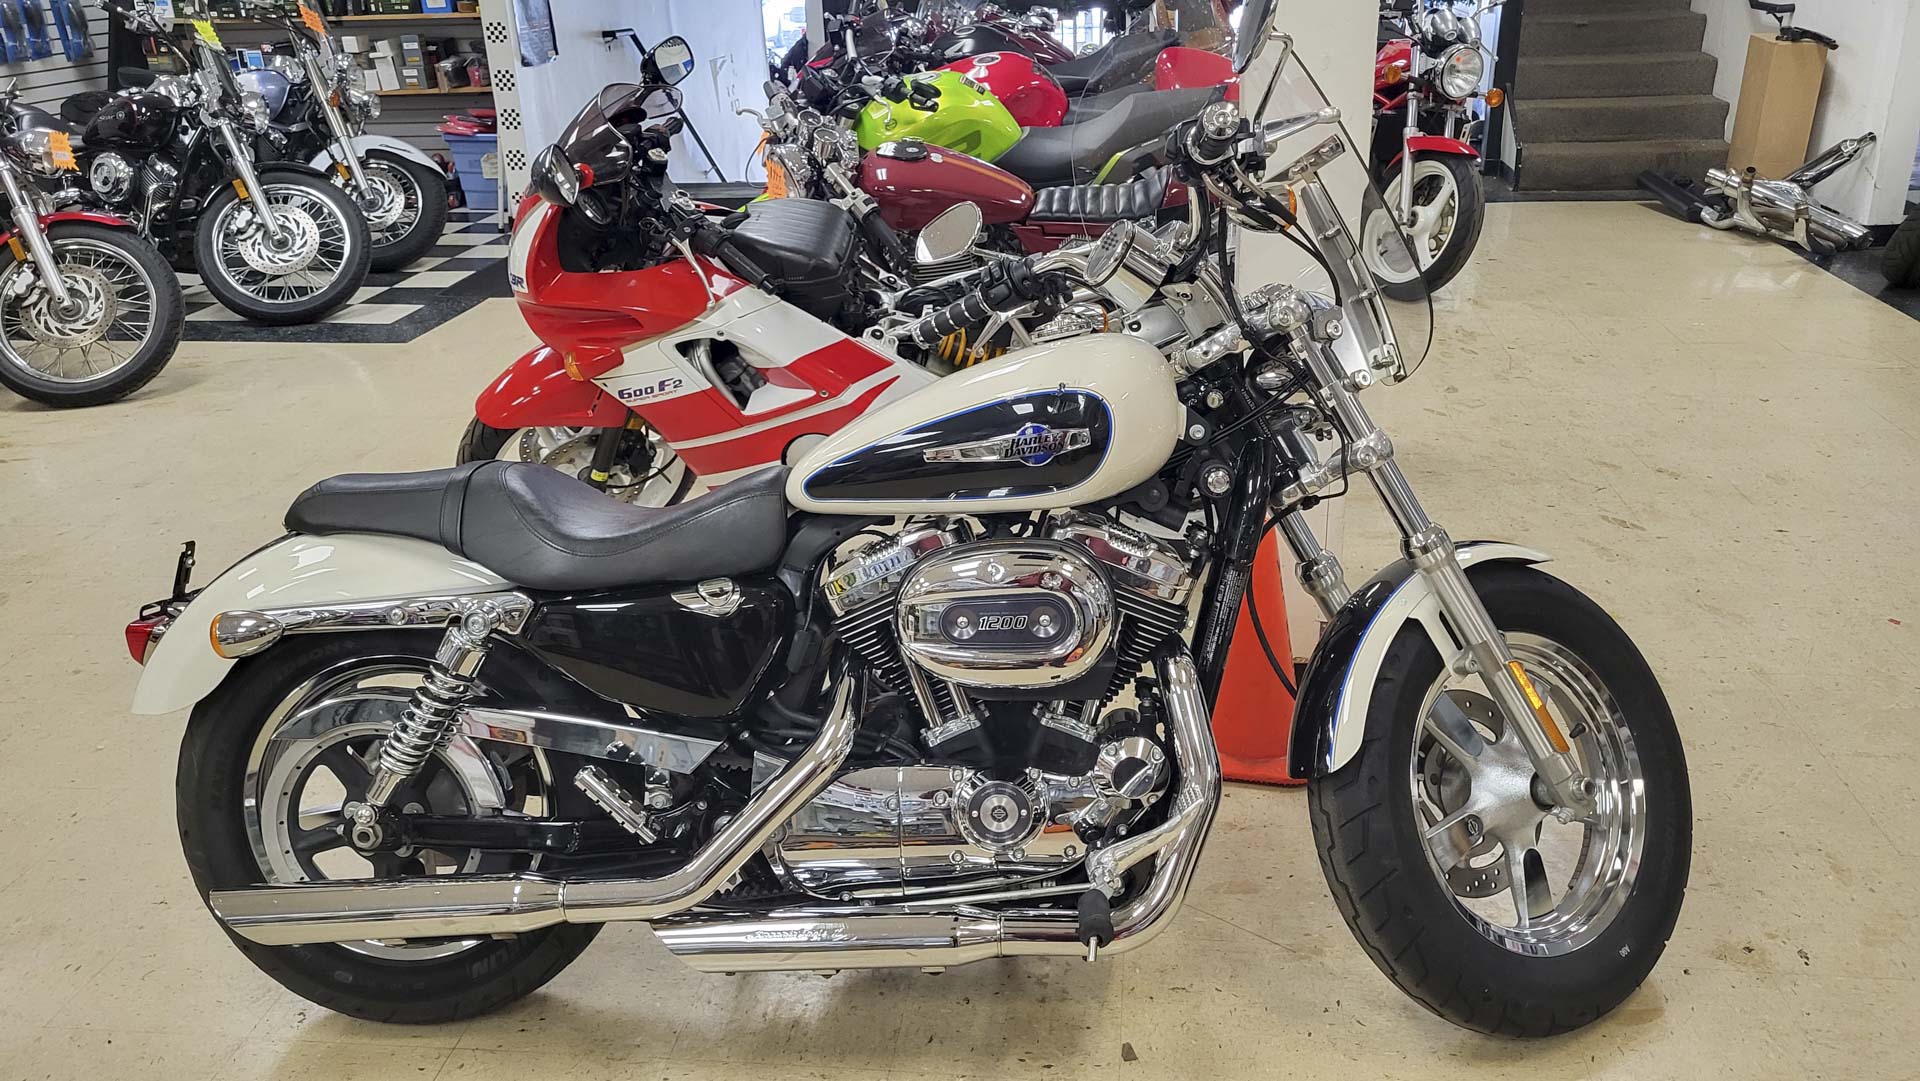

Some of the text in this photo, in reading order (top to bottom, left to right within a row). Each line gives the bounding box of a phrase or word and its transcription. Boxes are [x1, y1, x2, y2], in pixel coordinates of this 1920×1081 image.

[618, 378, 684, 399] 600 F2
[1004, 442, 1064, 458] DAVIDSON
[978, 615, 1028, 631] 1200
